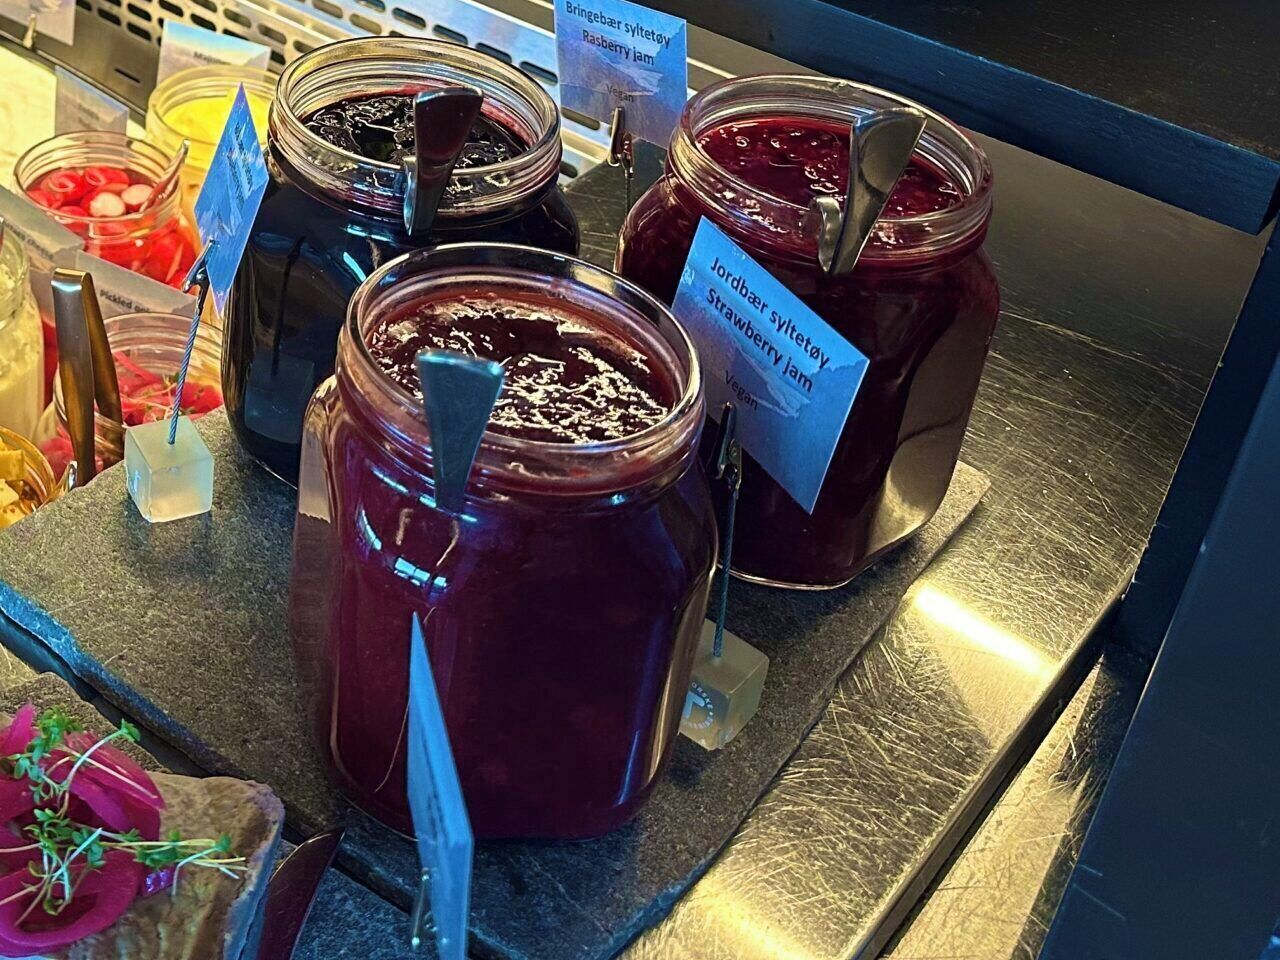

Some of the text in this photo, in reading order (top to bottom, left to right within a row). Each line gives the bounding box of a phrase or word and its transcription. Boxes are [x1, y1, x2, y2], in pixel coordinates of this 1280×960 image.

[565, 0, 671, 50] Bringebær syltetøy
[582, 29, 655, 66] Rasberry jam
[606, 83, 634, 103] Vegan
[710, 256, 830, 370] Jordbær syltetøy
[706, 287, 814, 394] Strawberry jam
[724, 370, 758, 412] Vegan
